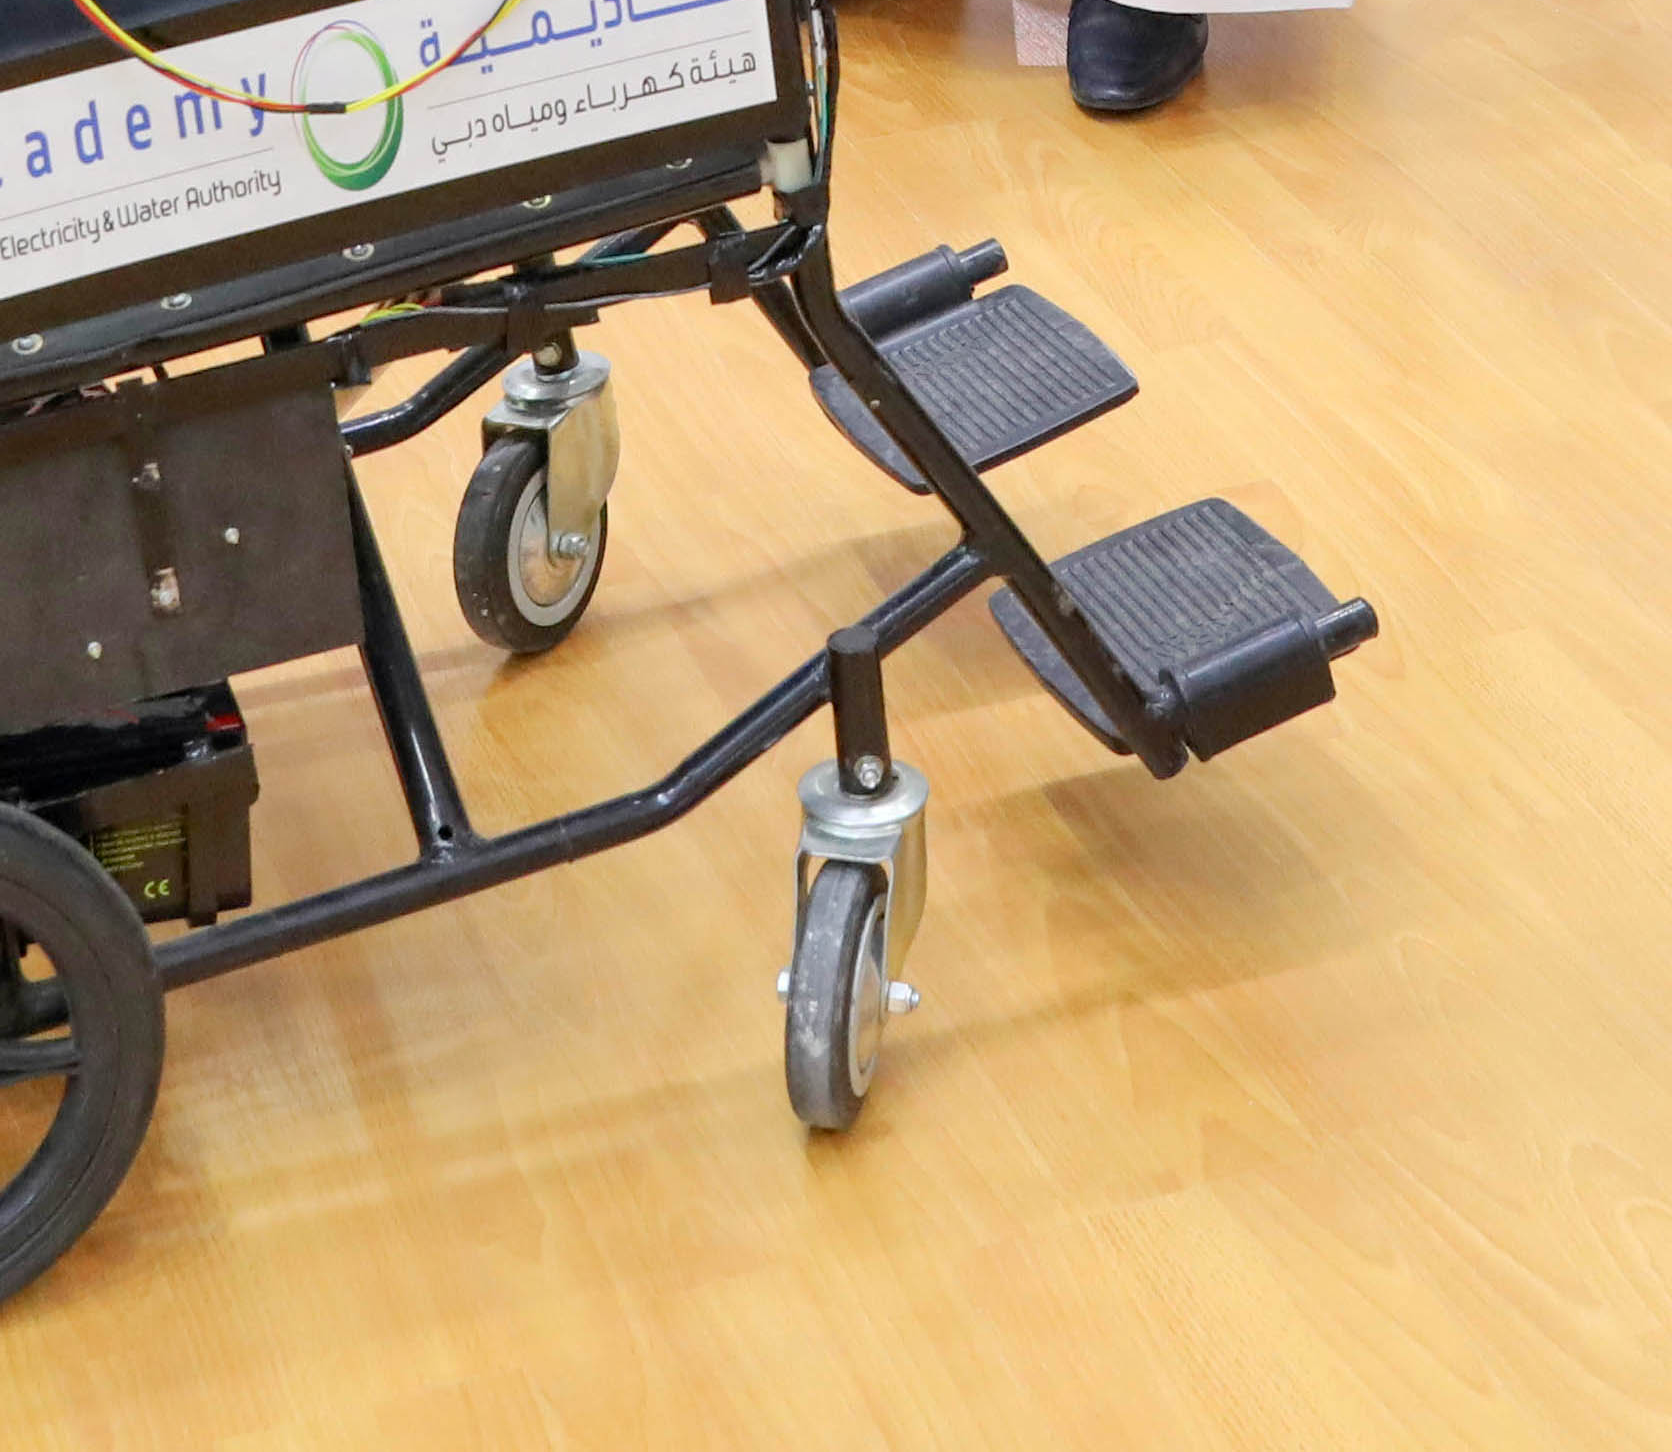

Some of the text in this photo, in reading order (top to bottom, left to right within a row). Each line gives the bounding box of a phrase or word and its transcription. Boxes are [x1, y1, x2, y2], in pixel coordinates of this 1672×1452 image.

[431, 50, 757, 164] هيئة كهرباء ومياه دبي
[0, 214, 102, 260] Electricity
[102, 208, 114, 233] &
[116, 195, 181, 228] Water
[185, 167, 282, 210] Authority
[144, 879, 171, 899] CE
